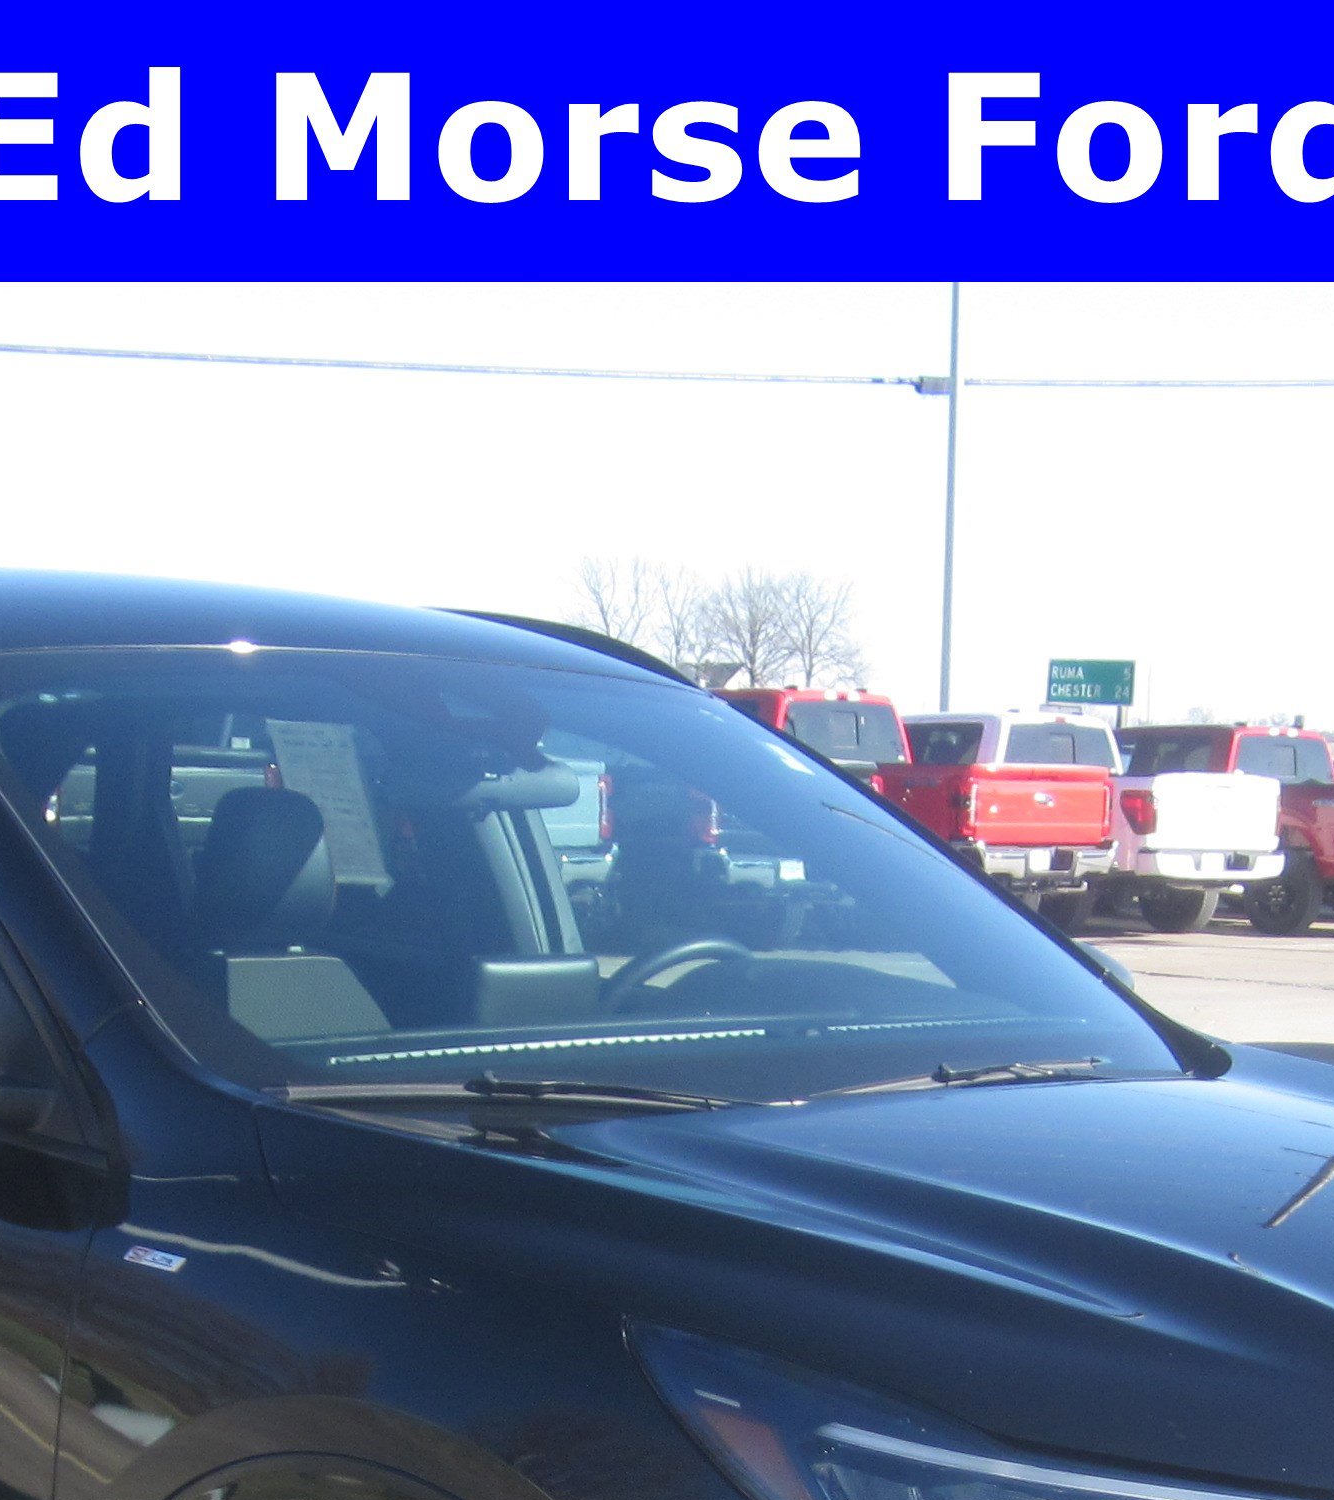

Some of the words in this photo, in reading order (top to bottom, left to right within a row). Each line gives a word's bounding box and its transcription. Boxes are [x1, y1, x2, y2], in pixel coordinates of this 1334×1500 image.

[1052, 665, 1084, 680] RUMA
[1050, 683, 1101, 698] CHESTER
[1115, 685, 1130, 699] 24
